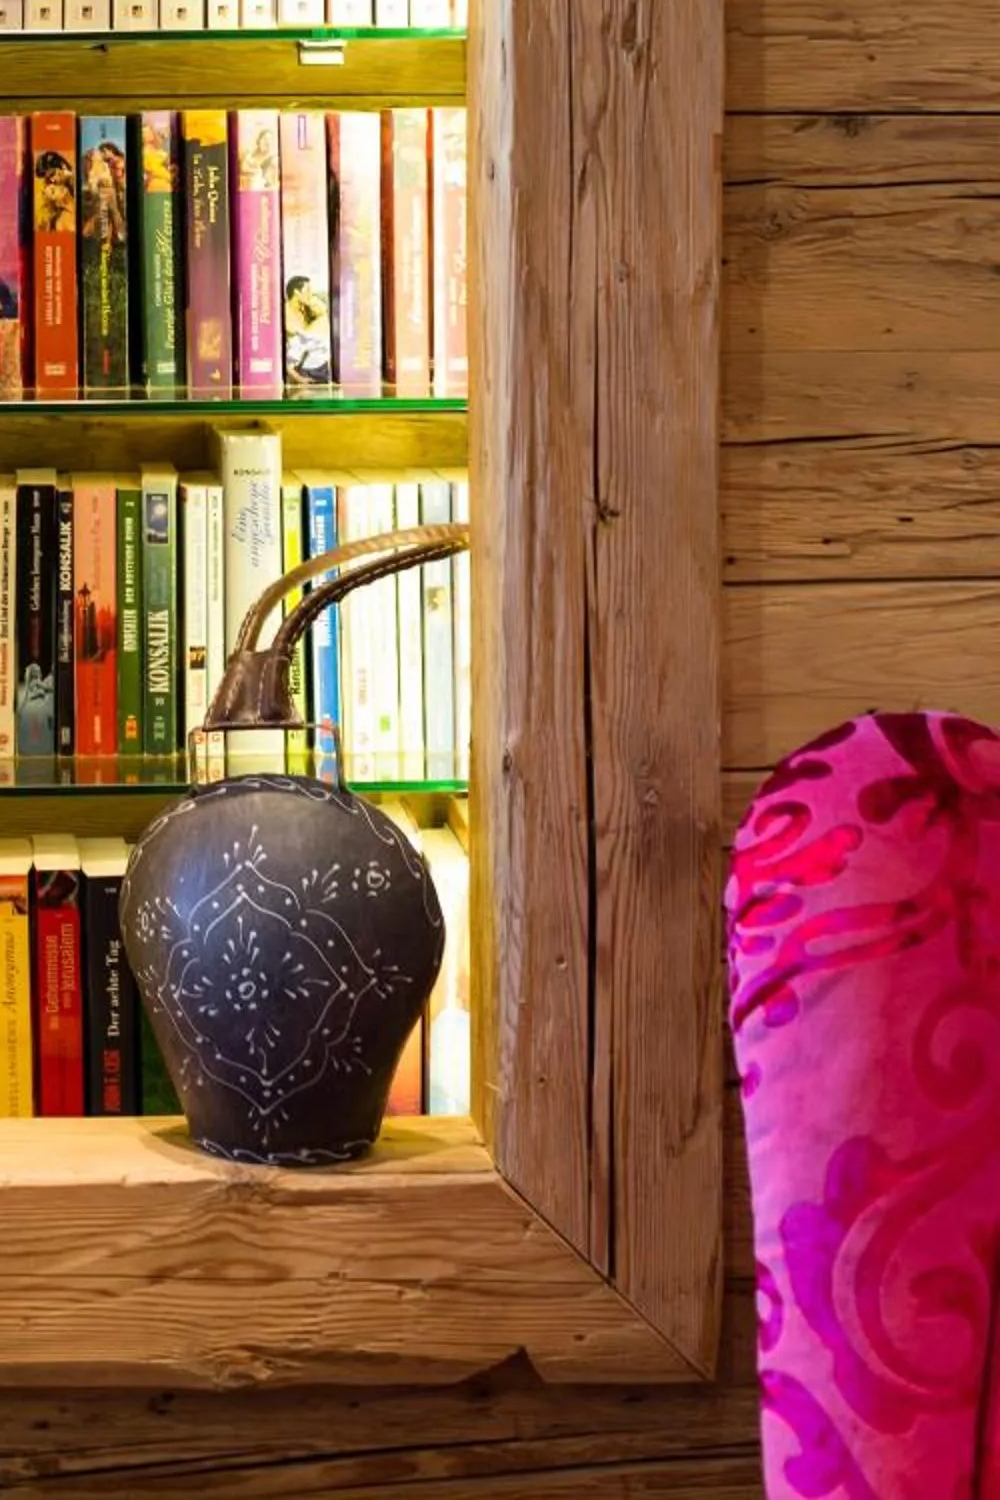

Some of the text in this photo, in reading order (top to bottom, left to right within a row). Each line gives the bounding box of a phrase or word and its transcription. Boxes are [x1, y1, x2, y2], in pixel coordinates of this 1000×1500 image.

[60, 522, 72, 591] KONSALIK
[148, 609, 170, 693] KONSALIK
[0, 931, 20, 1014] Anonymus
[60, 924, 76, 991] Jerusalem
[105, 940, 121, 966] Tag
[106, 970, 120, 1007] achte
[107, 1012, 120, 1037] Der
